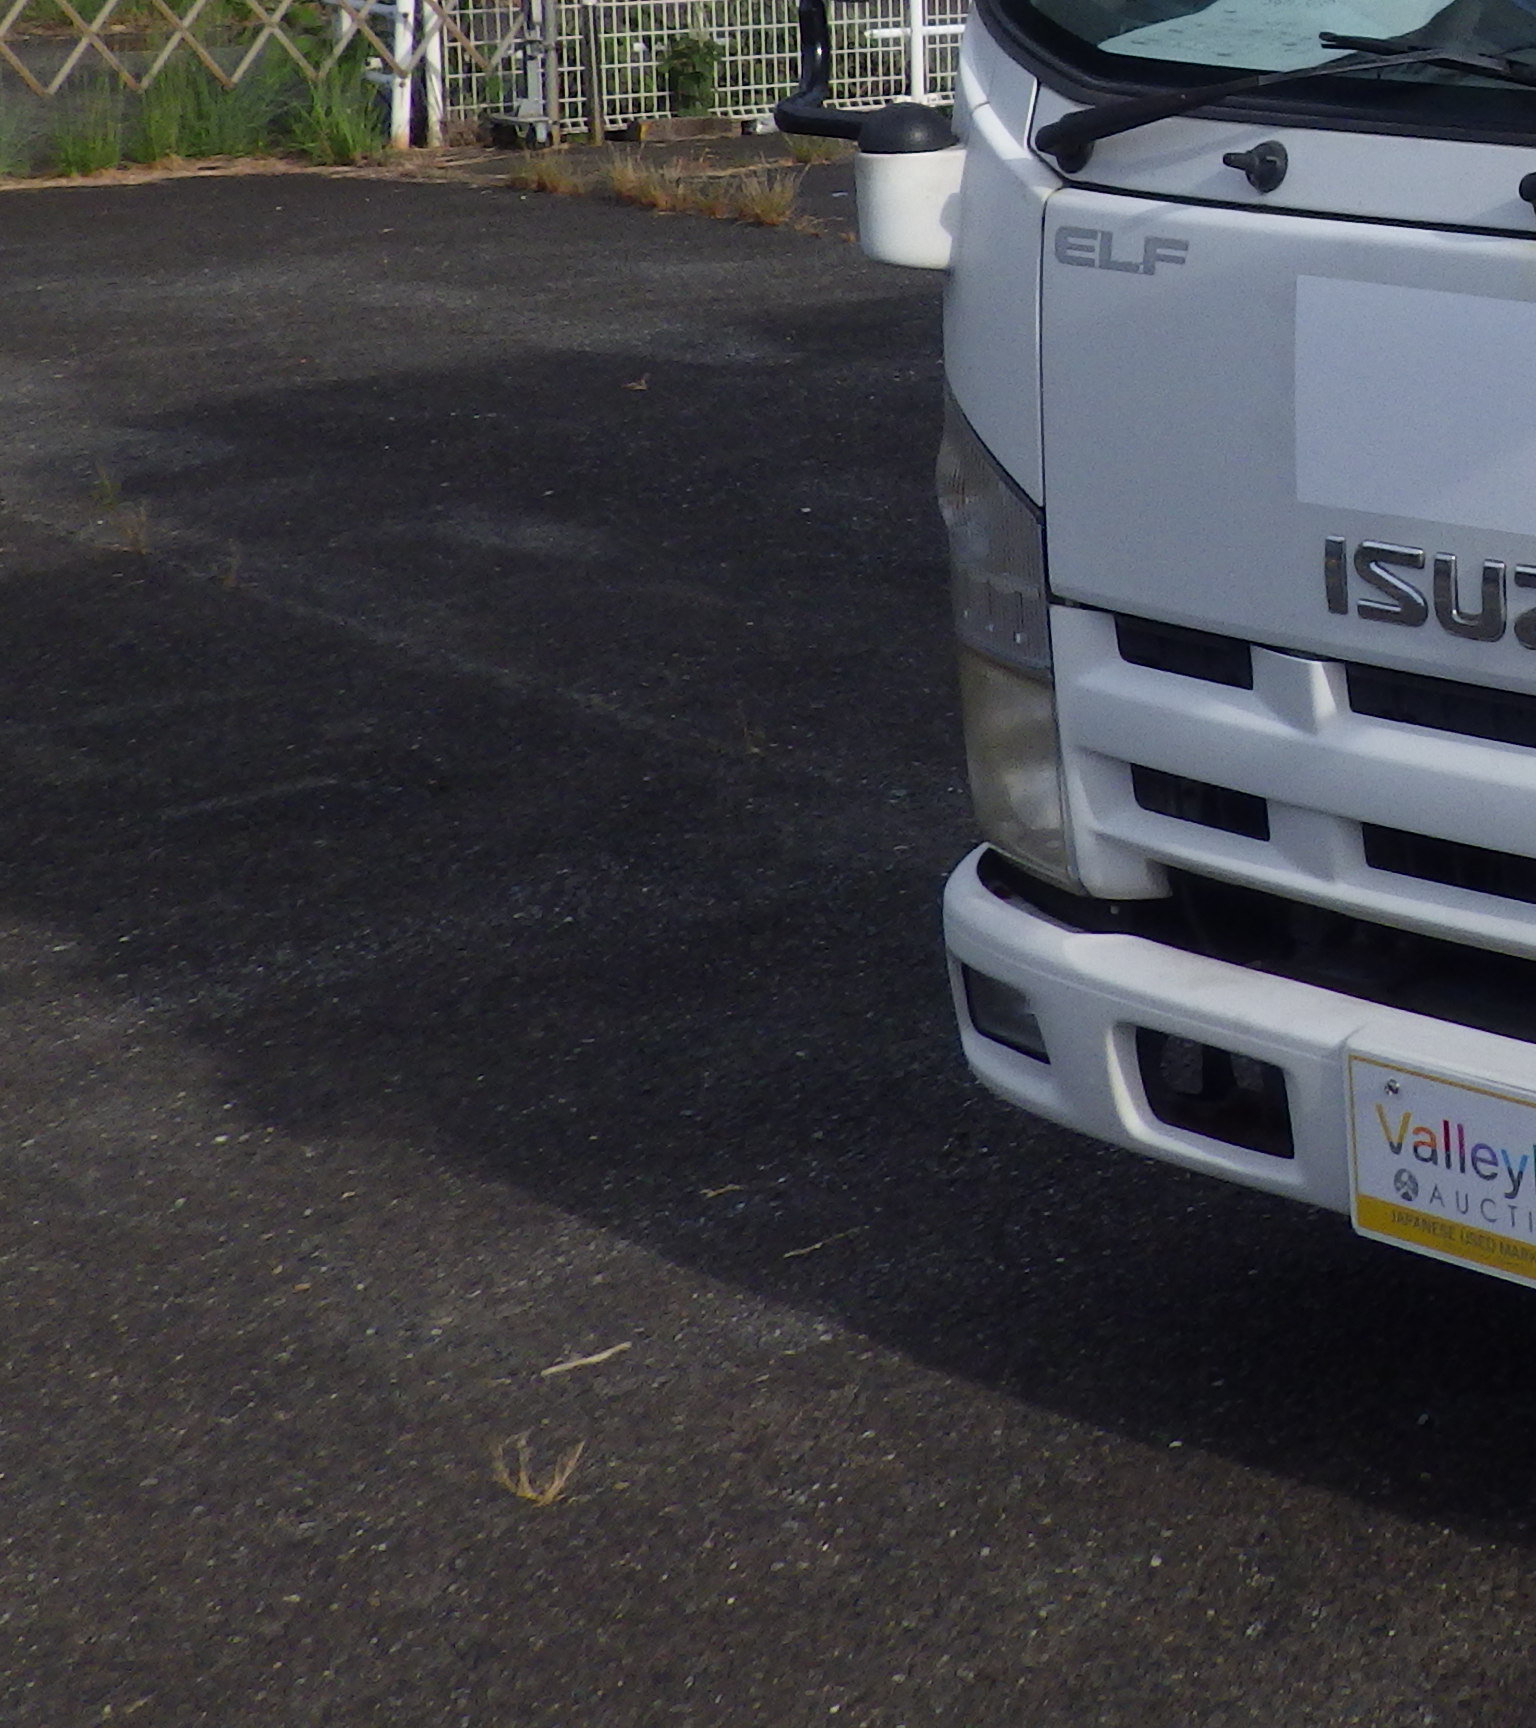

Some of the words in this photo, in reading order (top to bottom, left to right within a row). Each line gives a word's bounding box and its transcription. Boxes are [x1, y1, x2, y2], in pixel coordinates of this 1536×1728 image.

[1053, 225, 1190, 275] ELF
[1391, 1210, 1456, 1242] JAPANESE
[1460, 1227, 1496, 1254] USED
